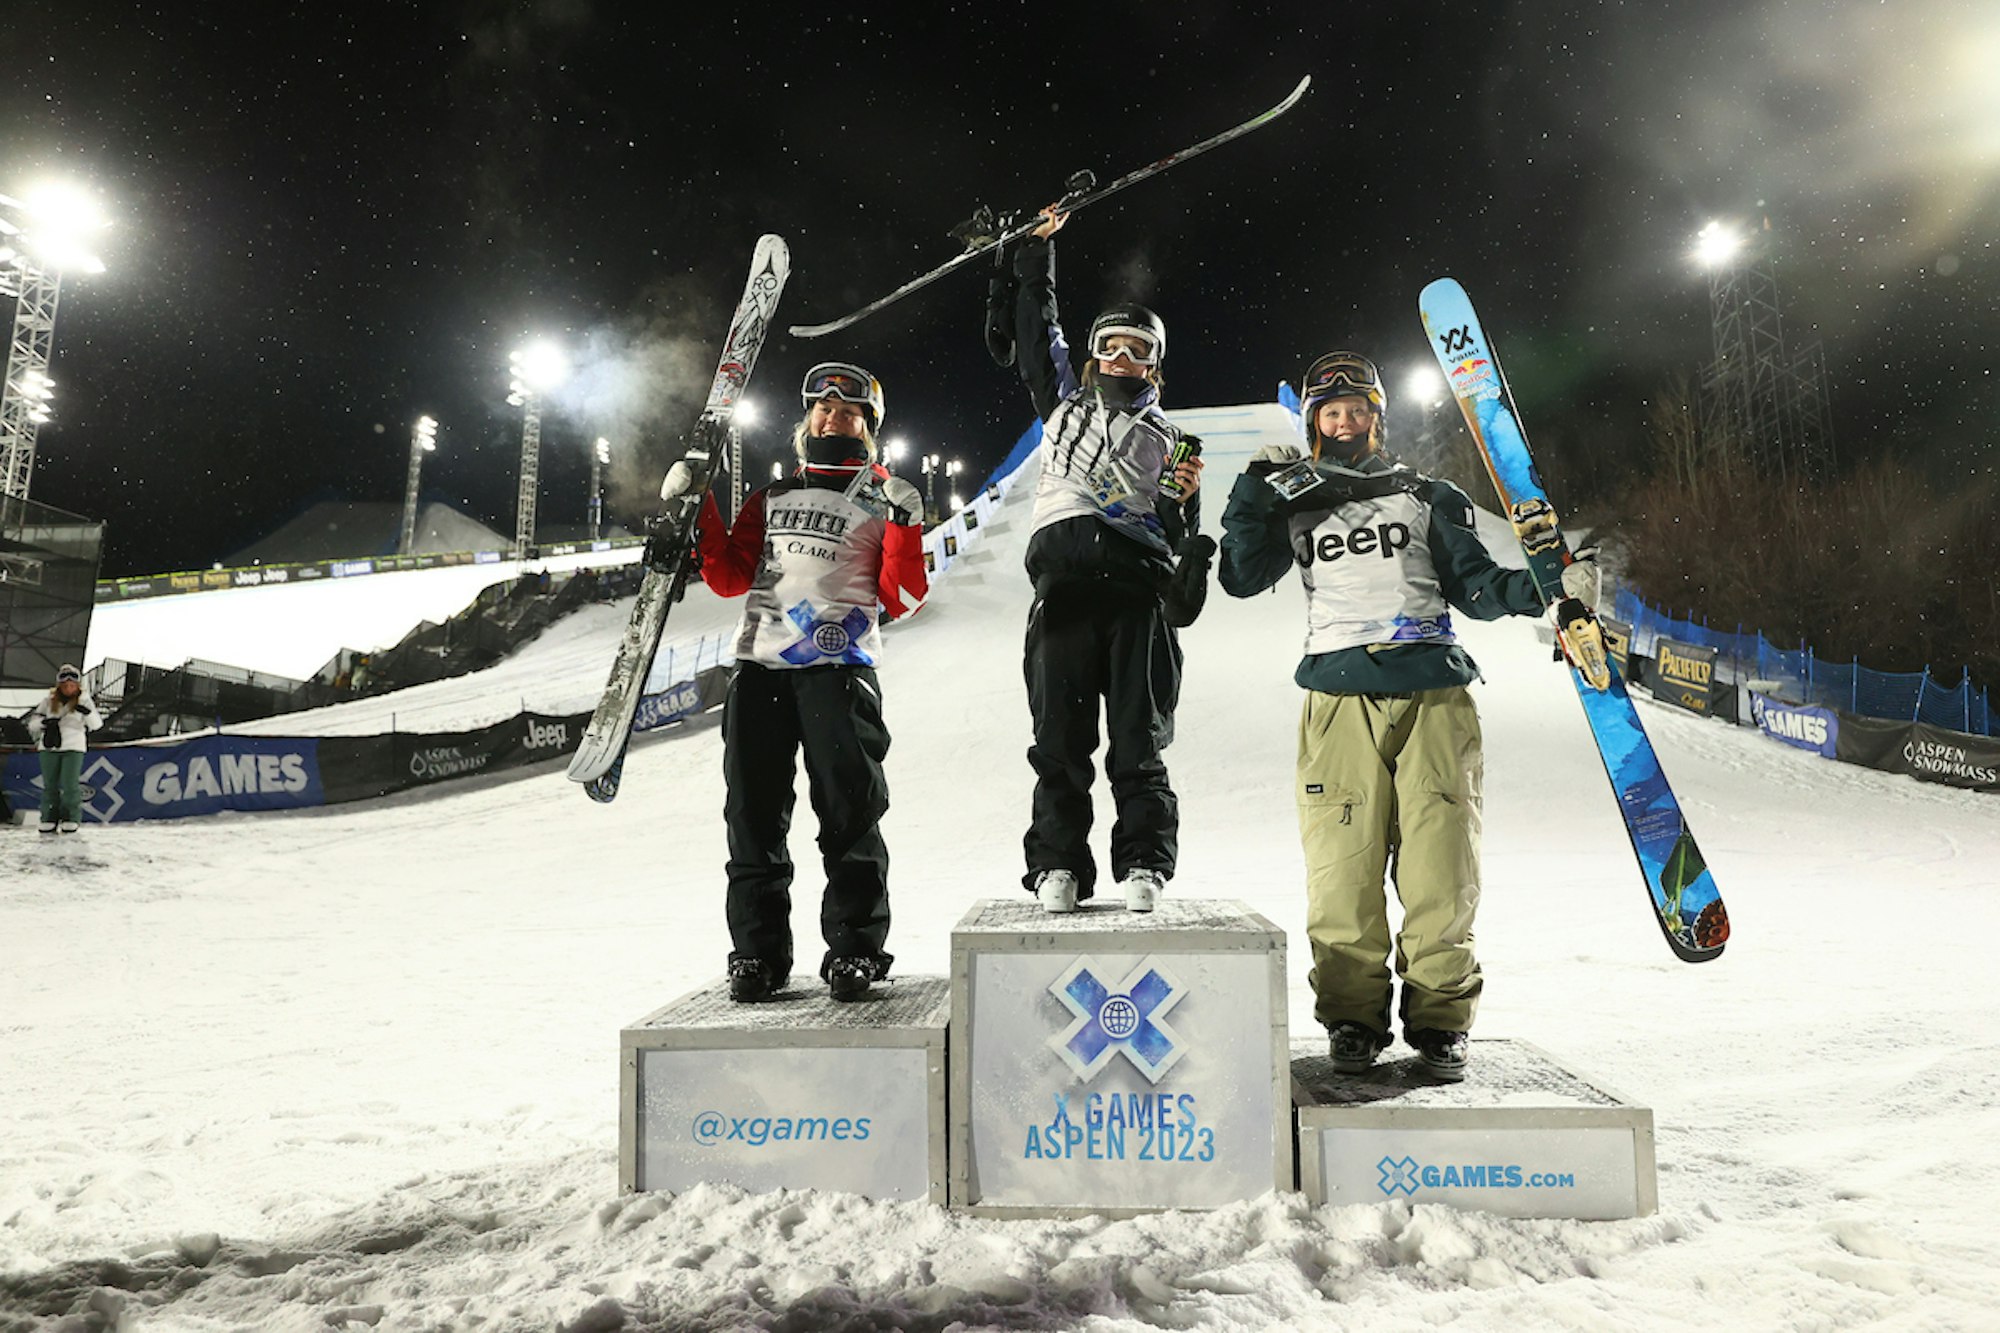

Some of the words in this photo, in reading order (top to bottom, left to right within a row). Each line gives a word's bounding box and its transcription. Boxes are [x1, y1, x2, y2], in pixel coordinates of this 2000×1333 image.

[787, 541, 836, 561] CLARA
[1298, 522, 1410, 568] Jeep
[1658, 646, 1711, 684] PACIFICO
[522, 719, 566, 749] Jeep
[1764, 709, 1828, 745] GAMES
[1914, 756, 1997, 783] SNOWMASS
[1915, 740, 1966, 762] ASPEN
[142, 753, 309, 805] GAMES
[691, 1110, 872, 1147] @xgames
[1052, 1091, 1072, 1128] X
[1085, 1092, 1197, 1130] GAMES
[1024, 1124, 1125, 1160] ASPEN
[1138, 1126, 1215, 1162] 2023
